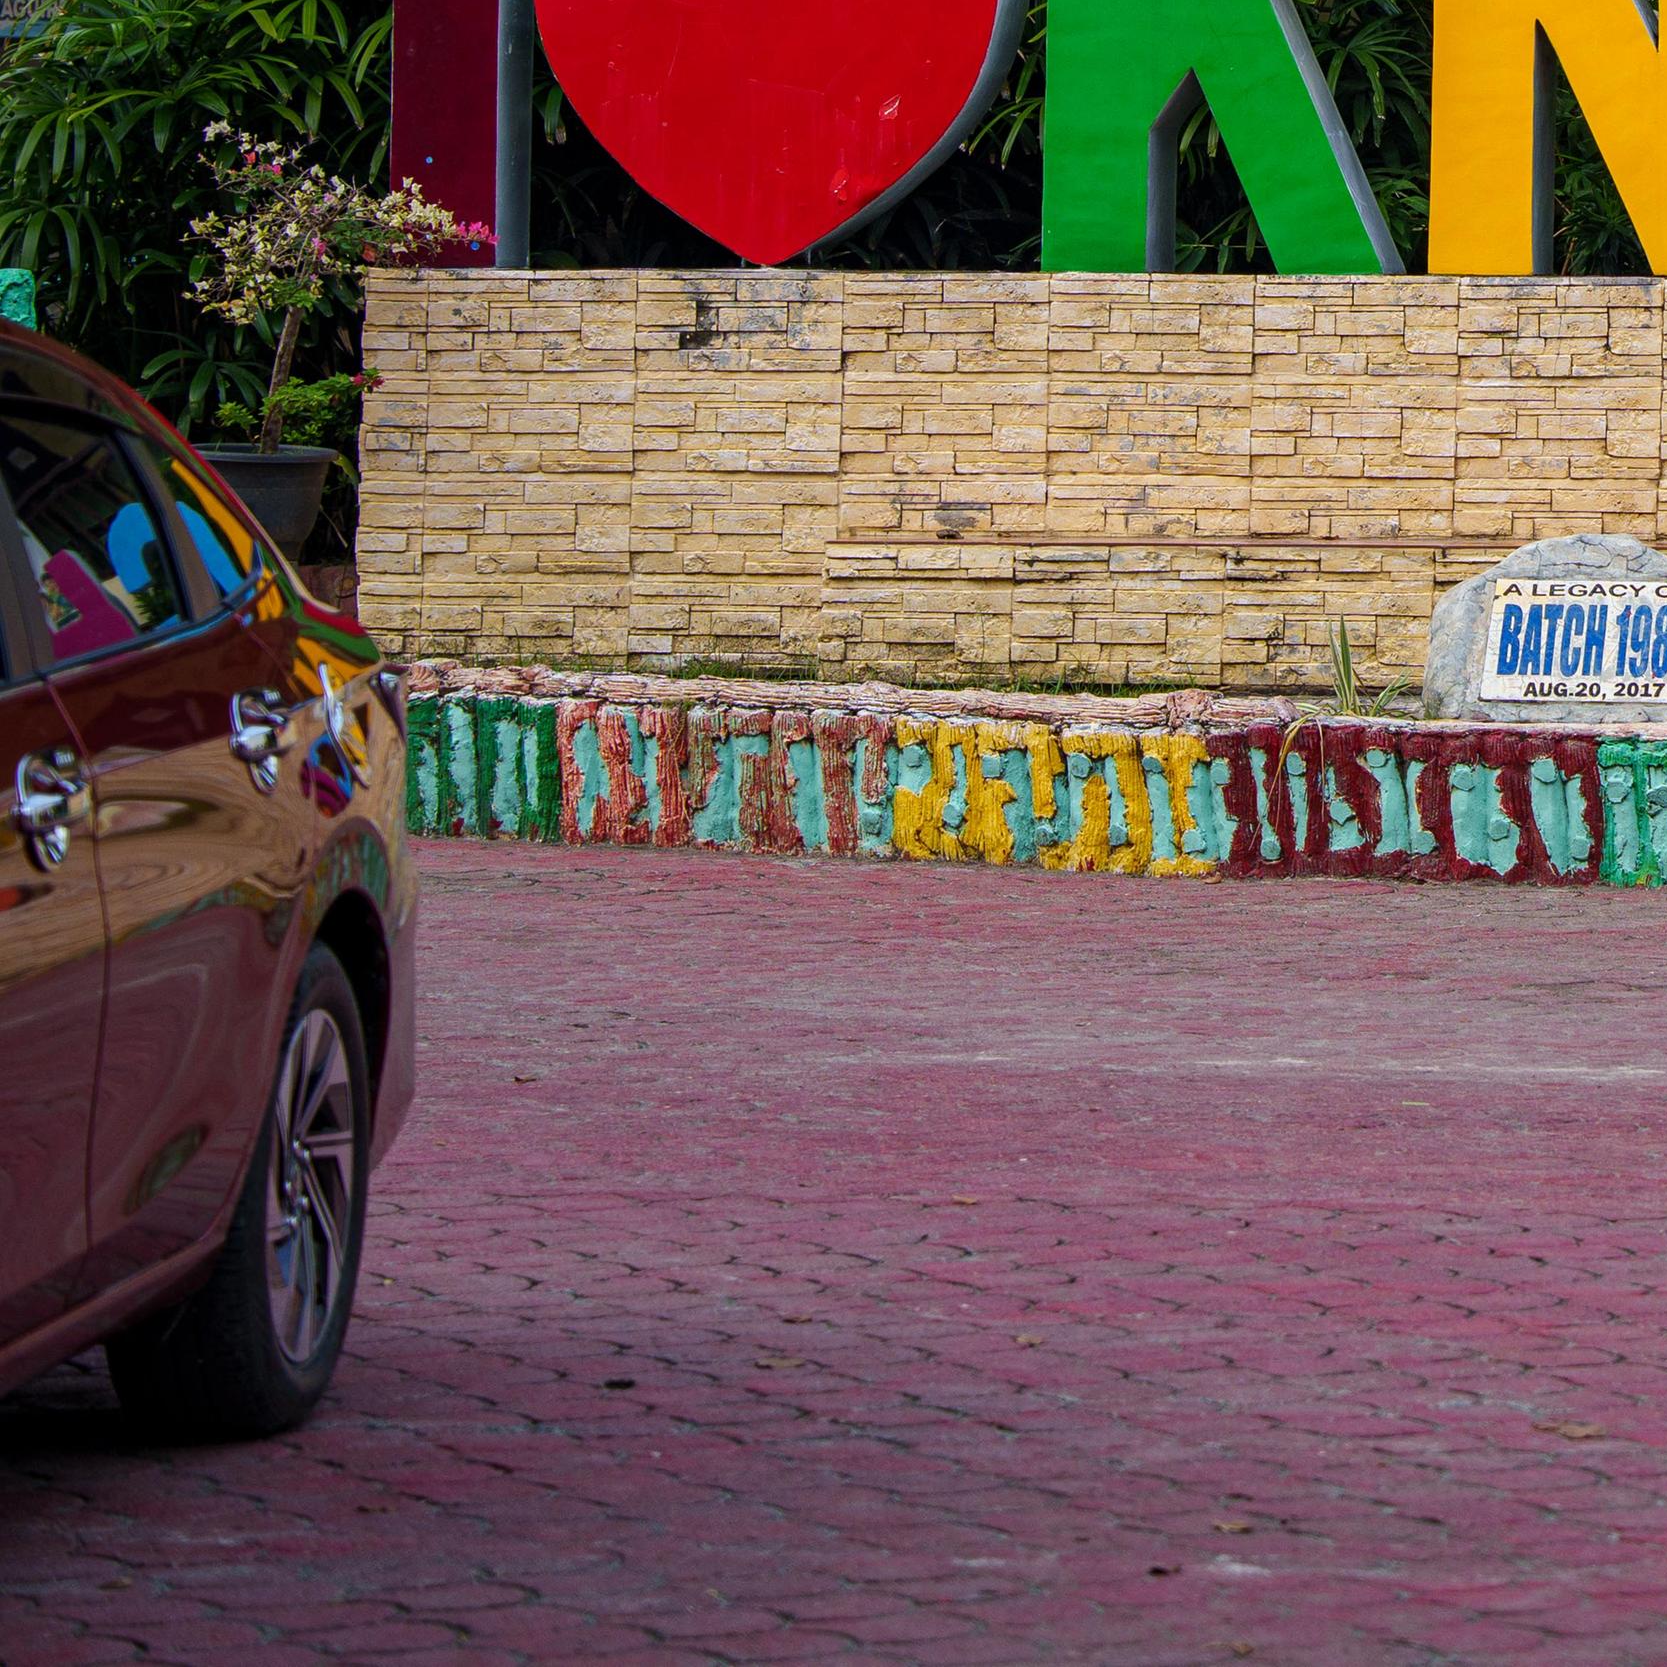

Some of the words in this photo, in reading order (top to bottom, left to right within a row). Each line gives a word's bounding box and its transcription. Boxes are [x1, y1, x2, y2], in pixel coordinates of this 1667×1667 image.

[1502, 583, 1523, 598] A
[1531, 584, 1647, 598] LEGACY
[1496, 603, 1609, 677] BATCH
[1522, 682, 1608, 701] AUG.20,
[1613, 683, 1667, 698] 2017
